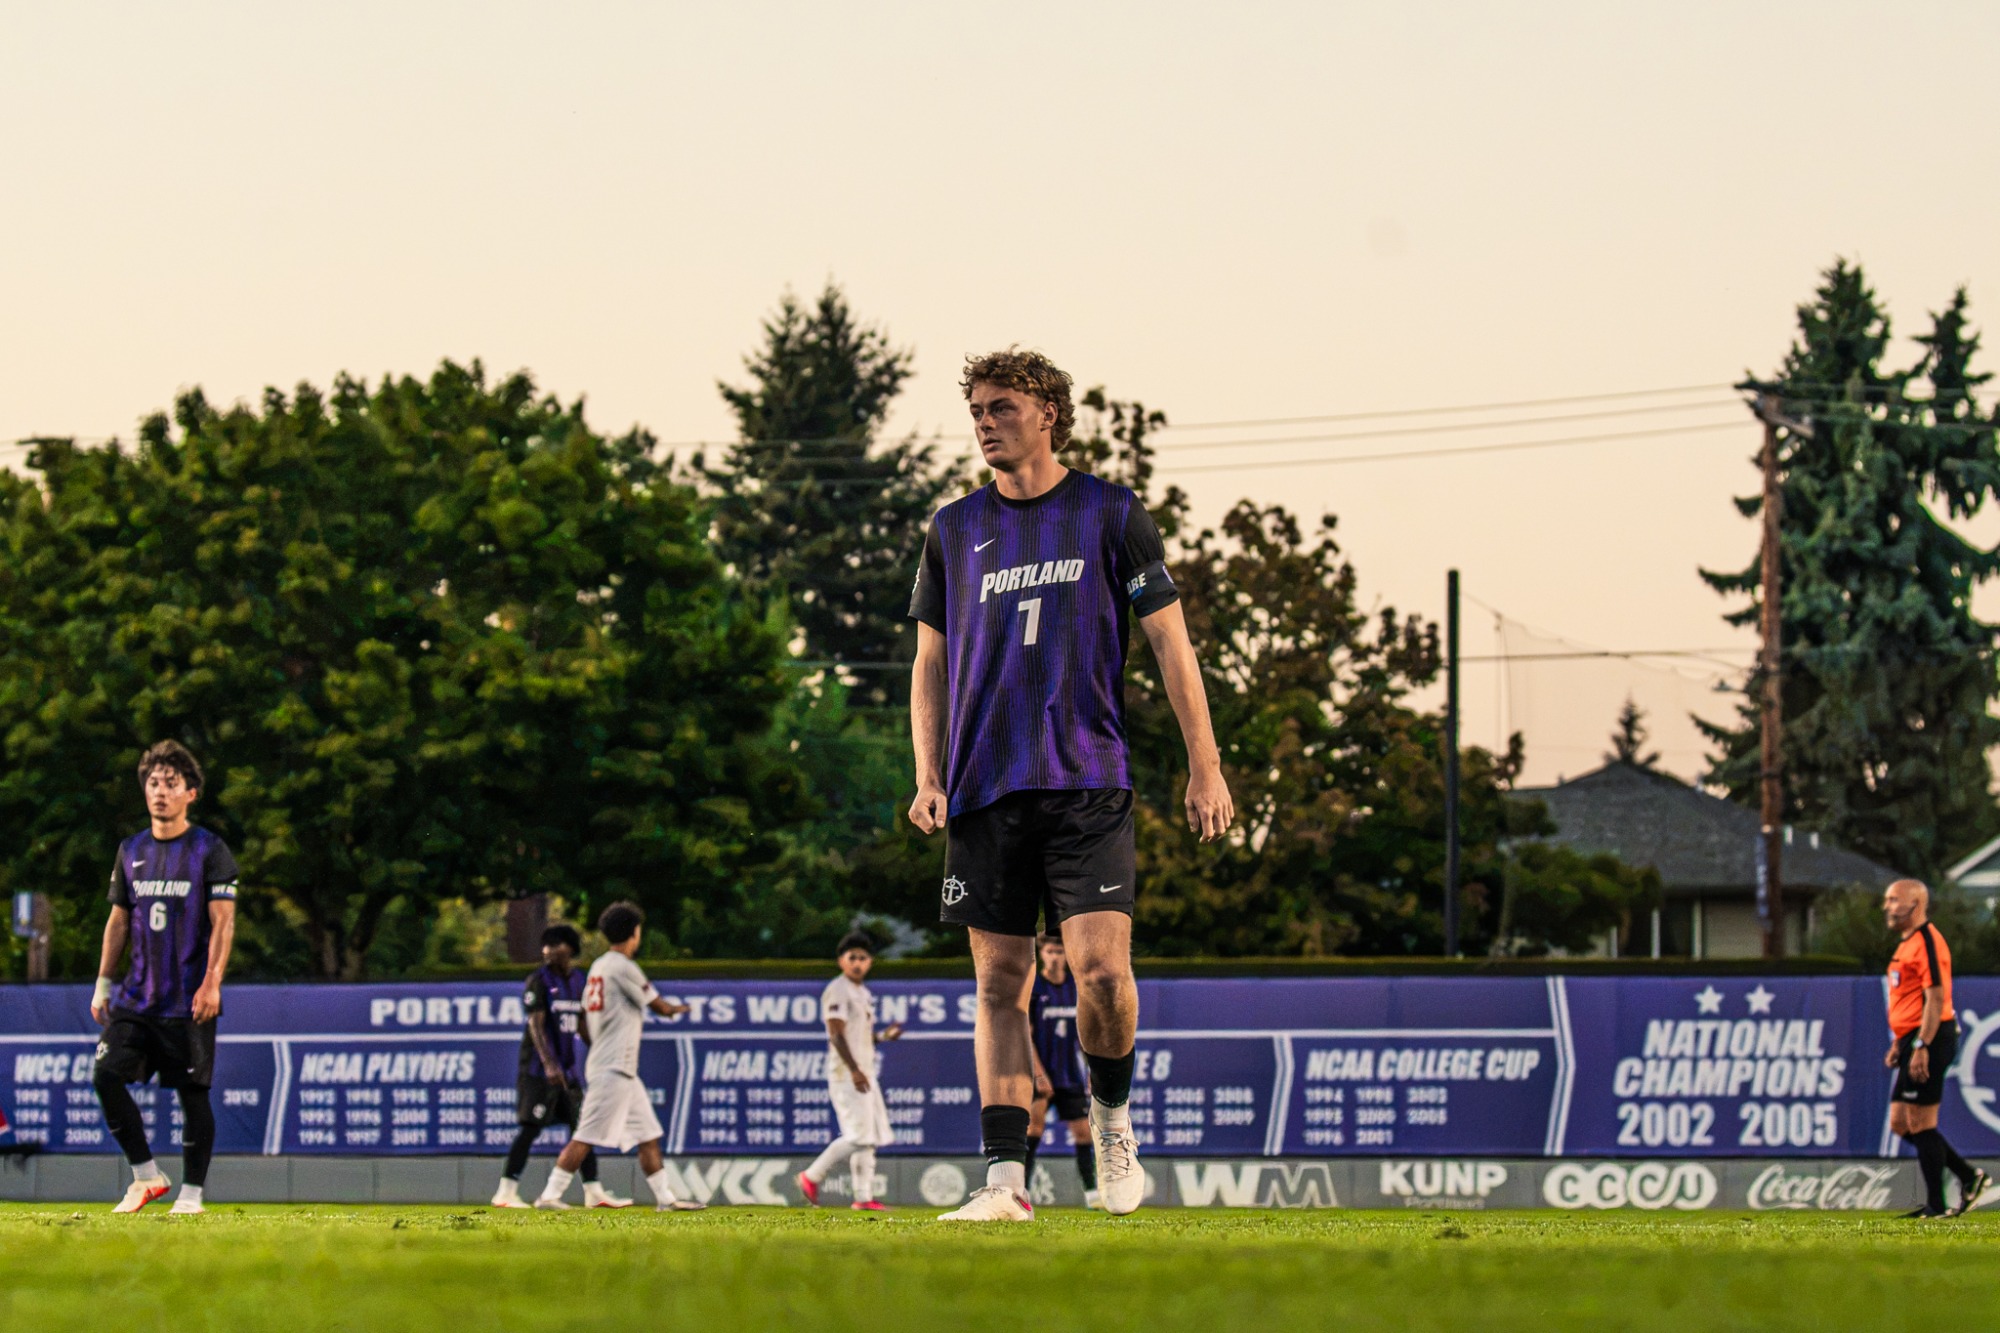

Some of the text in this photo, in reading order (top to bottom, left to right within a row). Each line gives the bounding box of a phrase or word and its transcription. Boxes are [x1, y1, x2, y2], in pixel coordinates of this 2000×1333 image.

[979, 558, 1085, 604] PORTLAND
[1018, 598, 1042, 646] 7
[132, 880, 192, 899] PORTLAND
[149, 901, 167, 931] 6
[588, 976, 604, 1012] 23
[371, 997, 523, 1024] PORTLA
[560, 1013, 578, 1032] 30
[1644, 1020, 1824, 1057] NATIONAL
[15, 1055, 69, 1082] WCC
[300, 1053, 475, 1082] NCAA PLAYOFFS
[703, 1051, 827, 1080] NCAA SWE
[1152, 1051, 1171, 1080] 8
[1306, 1049, 1539, 1080] NCAA COLLEGE CUP
[1614, 1057, 1846, 1097] CHAMPIONS
[1618, 1103, 1836, 1146] 2002 2005
[663, 1160, 790, 1206] WCC
[1380, 1161, 1507, 1196] KUNP
